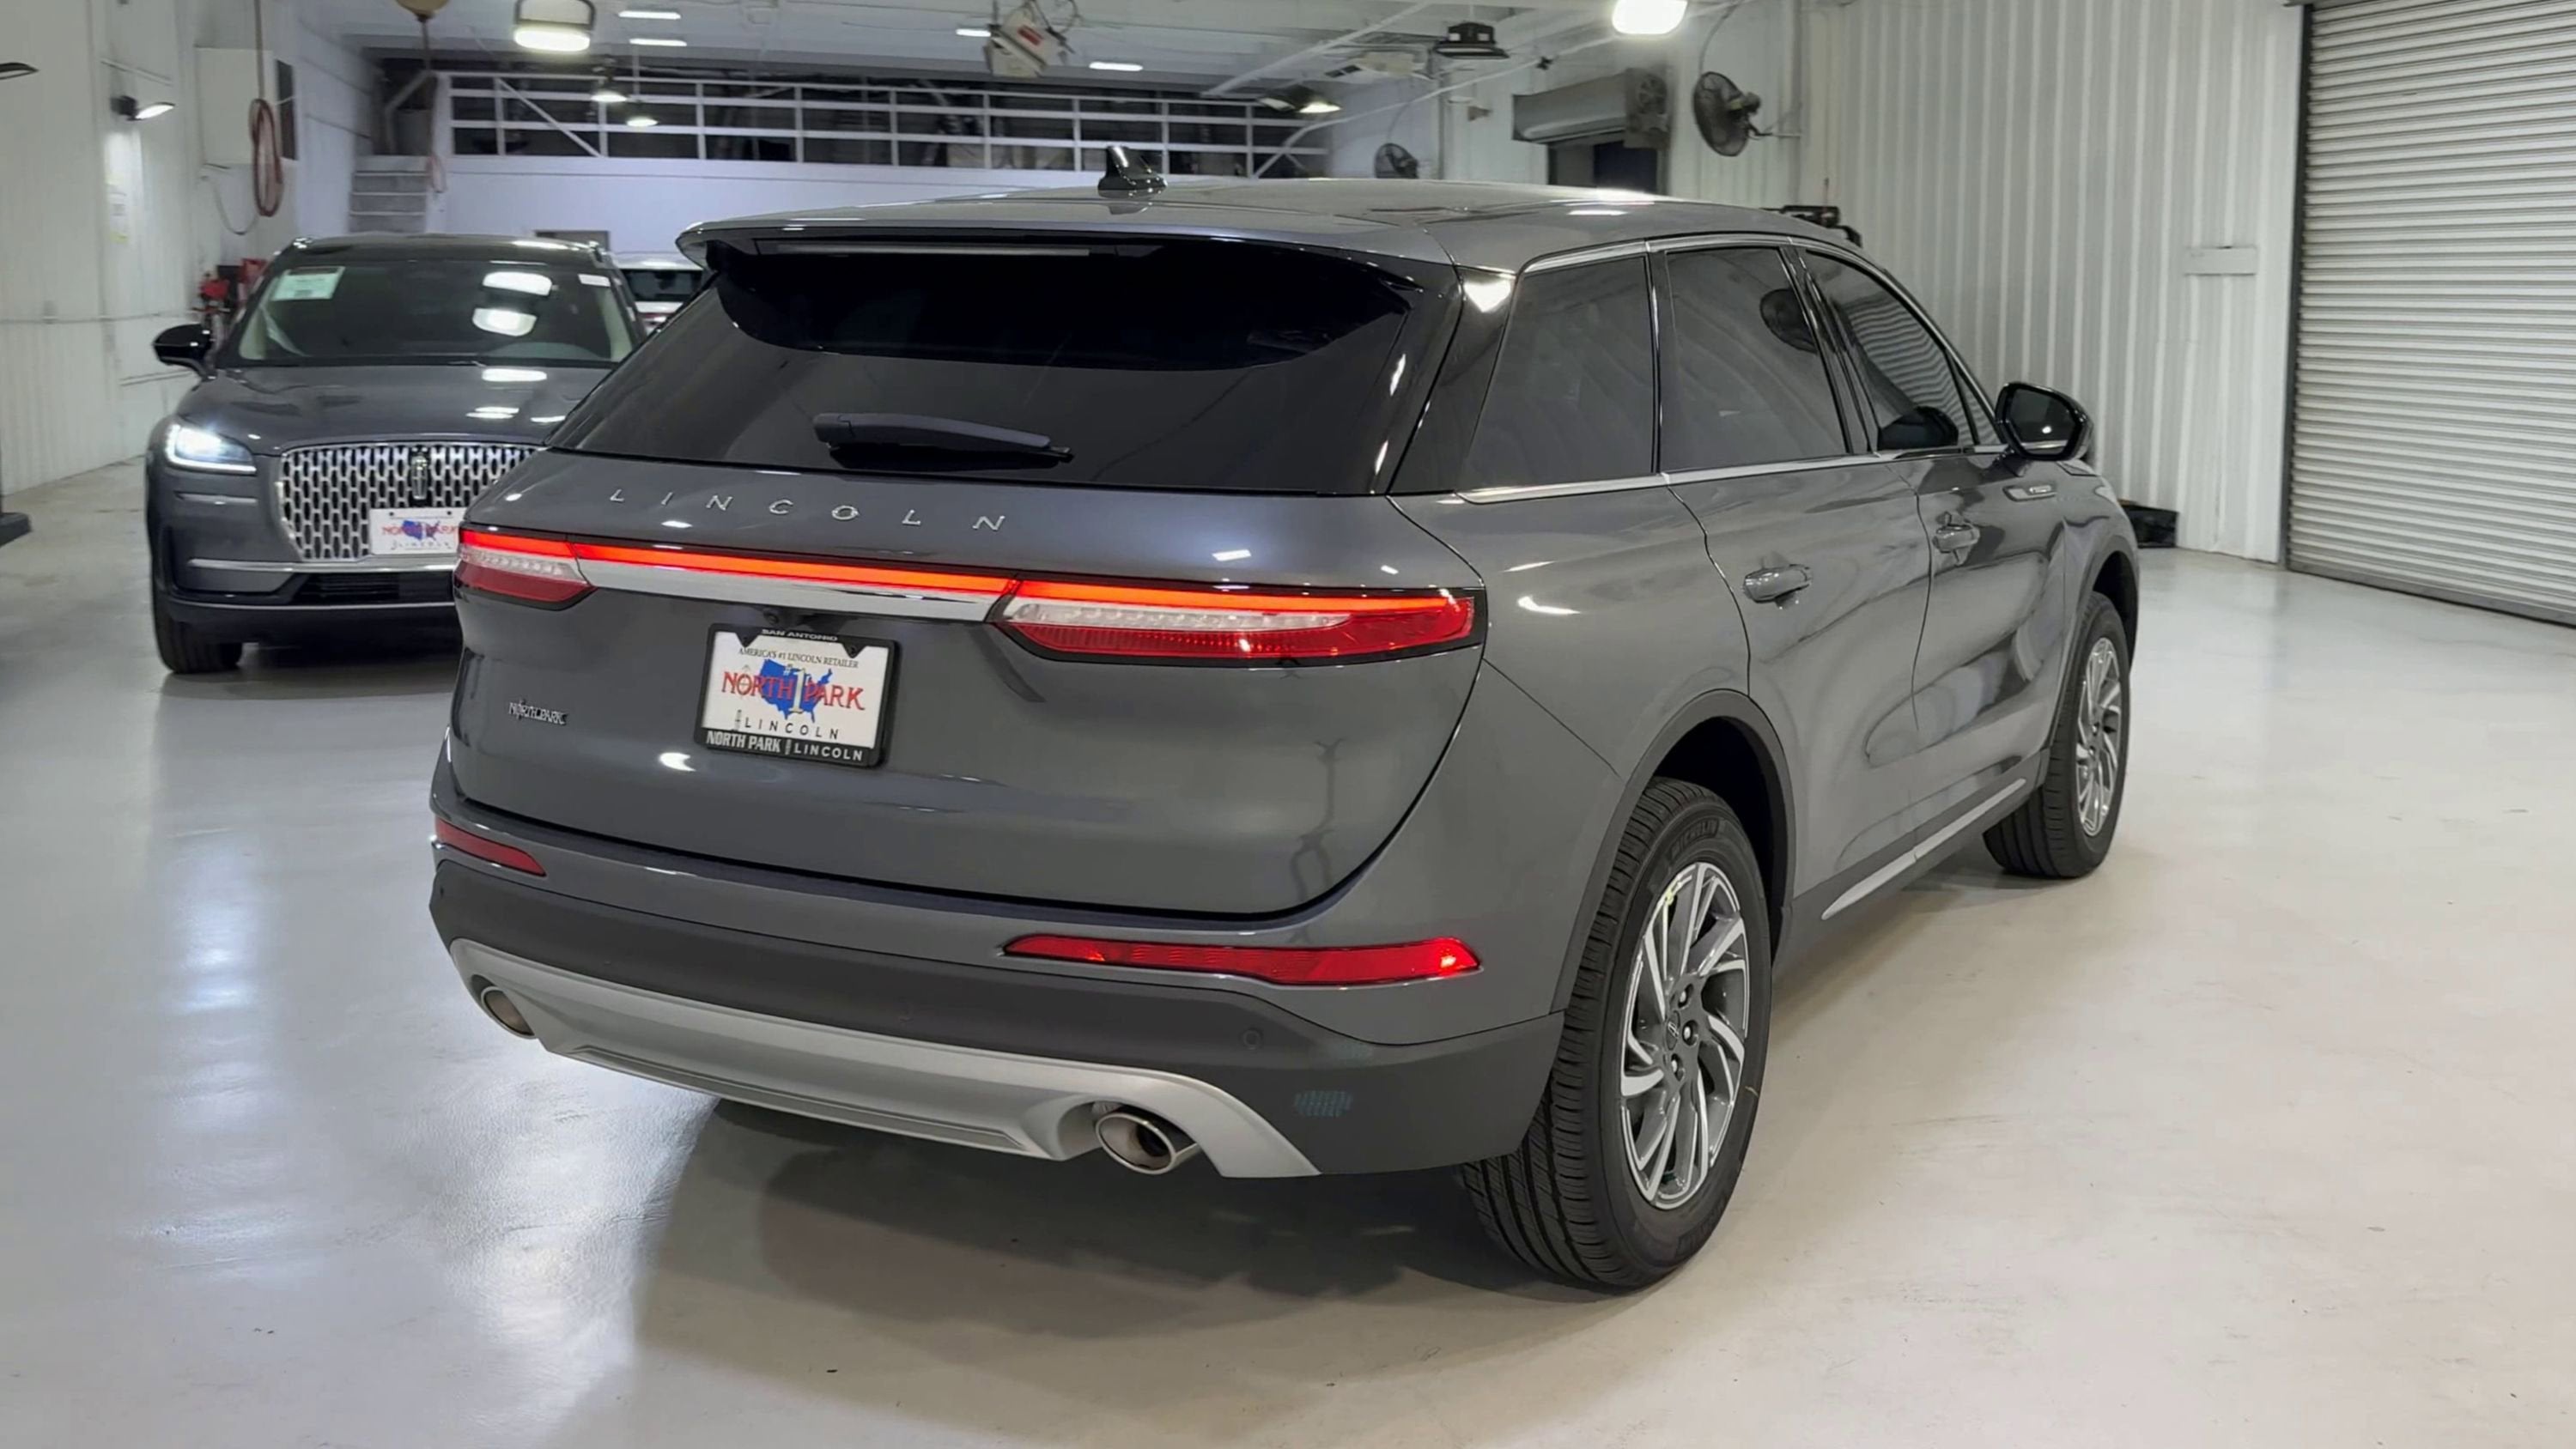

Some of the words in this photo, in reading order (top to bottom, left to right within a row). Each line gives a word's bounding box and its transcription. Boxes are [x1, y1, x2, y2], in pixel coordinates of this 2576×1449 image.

[609, 488, 1005, 531] LINCOLN
[787, 632, 838, 641] ANTONIO
[739, 647, 777, 658] AMERICA'S
[787, 652, 822, 664] LINCOLN
[823, 657, 860, 669] RETAILER
[721, 671, 794, 700] NORTH
[803, 682, 866, 711] PARK
[744, 717, 840, 740] LINCOLN
[706, 731, 746, 749] NORTH
[748, 736, 781, 753] PARK
[794, 743, 863, 761] LINCOLN
